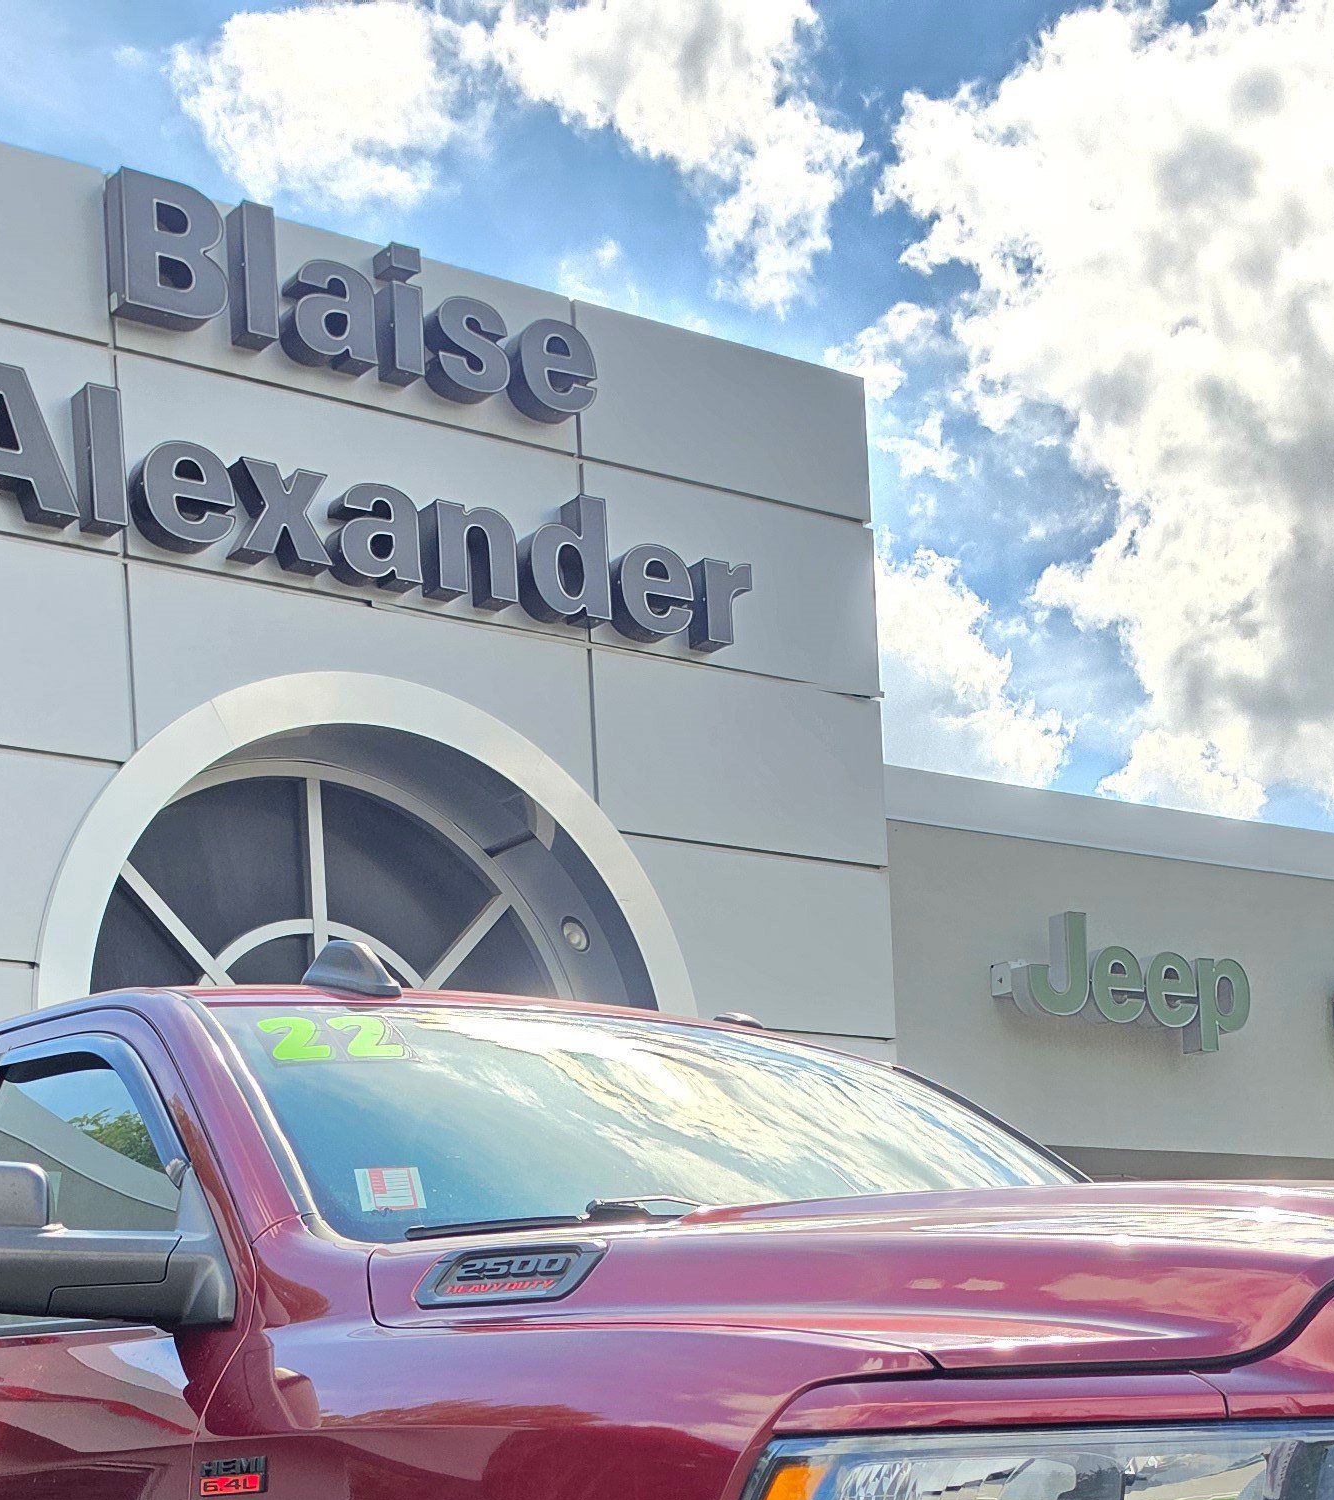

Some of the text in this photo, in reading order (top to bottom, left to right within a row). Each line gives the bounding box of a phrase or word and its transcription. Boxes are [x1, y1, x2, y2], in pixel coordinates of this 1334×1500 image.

[105, 166, 598, 424] Blaise
[1011, 910, 1252, 1055] Jeep
[257, 1016, 405, 1061] 22
[456, 1256, 571, 1281] 2500
[200, 1456, 267, 1477] HEMI
[203, 1479, 258, 1493] 6.4L
